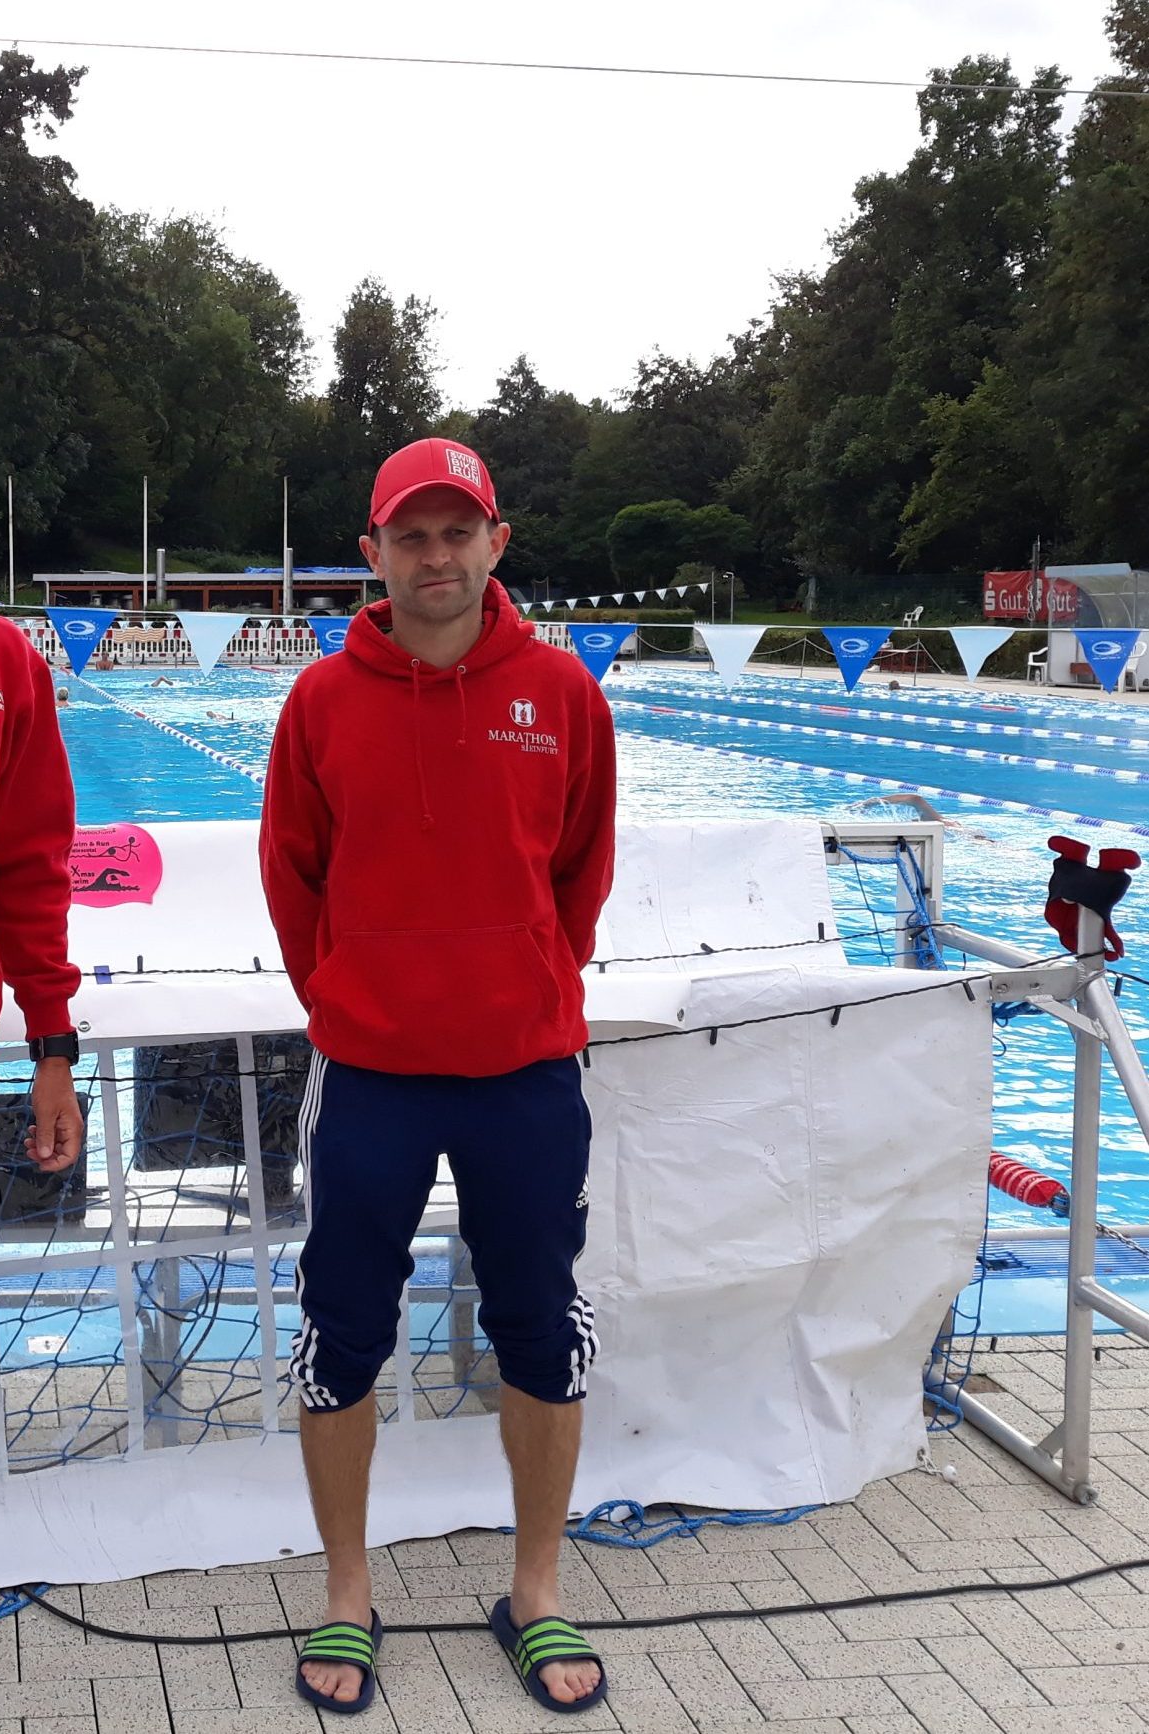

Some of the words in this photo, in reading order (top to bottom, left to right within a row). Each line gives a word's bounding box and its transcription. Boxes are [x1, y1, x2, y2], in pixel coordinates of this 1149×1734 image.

[450, 451, 477, 467] SWIM
[452, 458, 478, 475] BIKE
[453, 466, 480, 486] RUN
[999, 589, 1026, 610] Gut.
[488, 729, 557, 747] MARATHON
[521, 744, 559, 755] STEINFURT
[71, 865, 95, 877] Xmas
